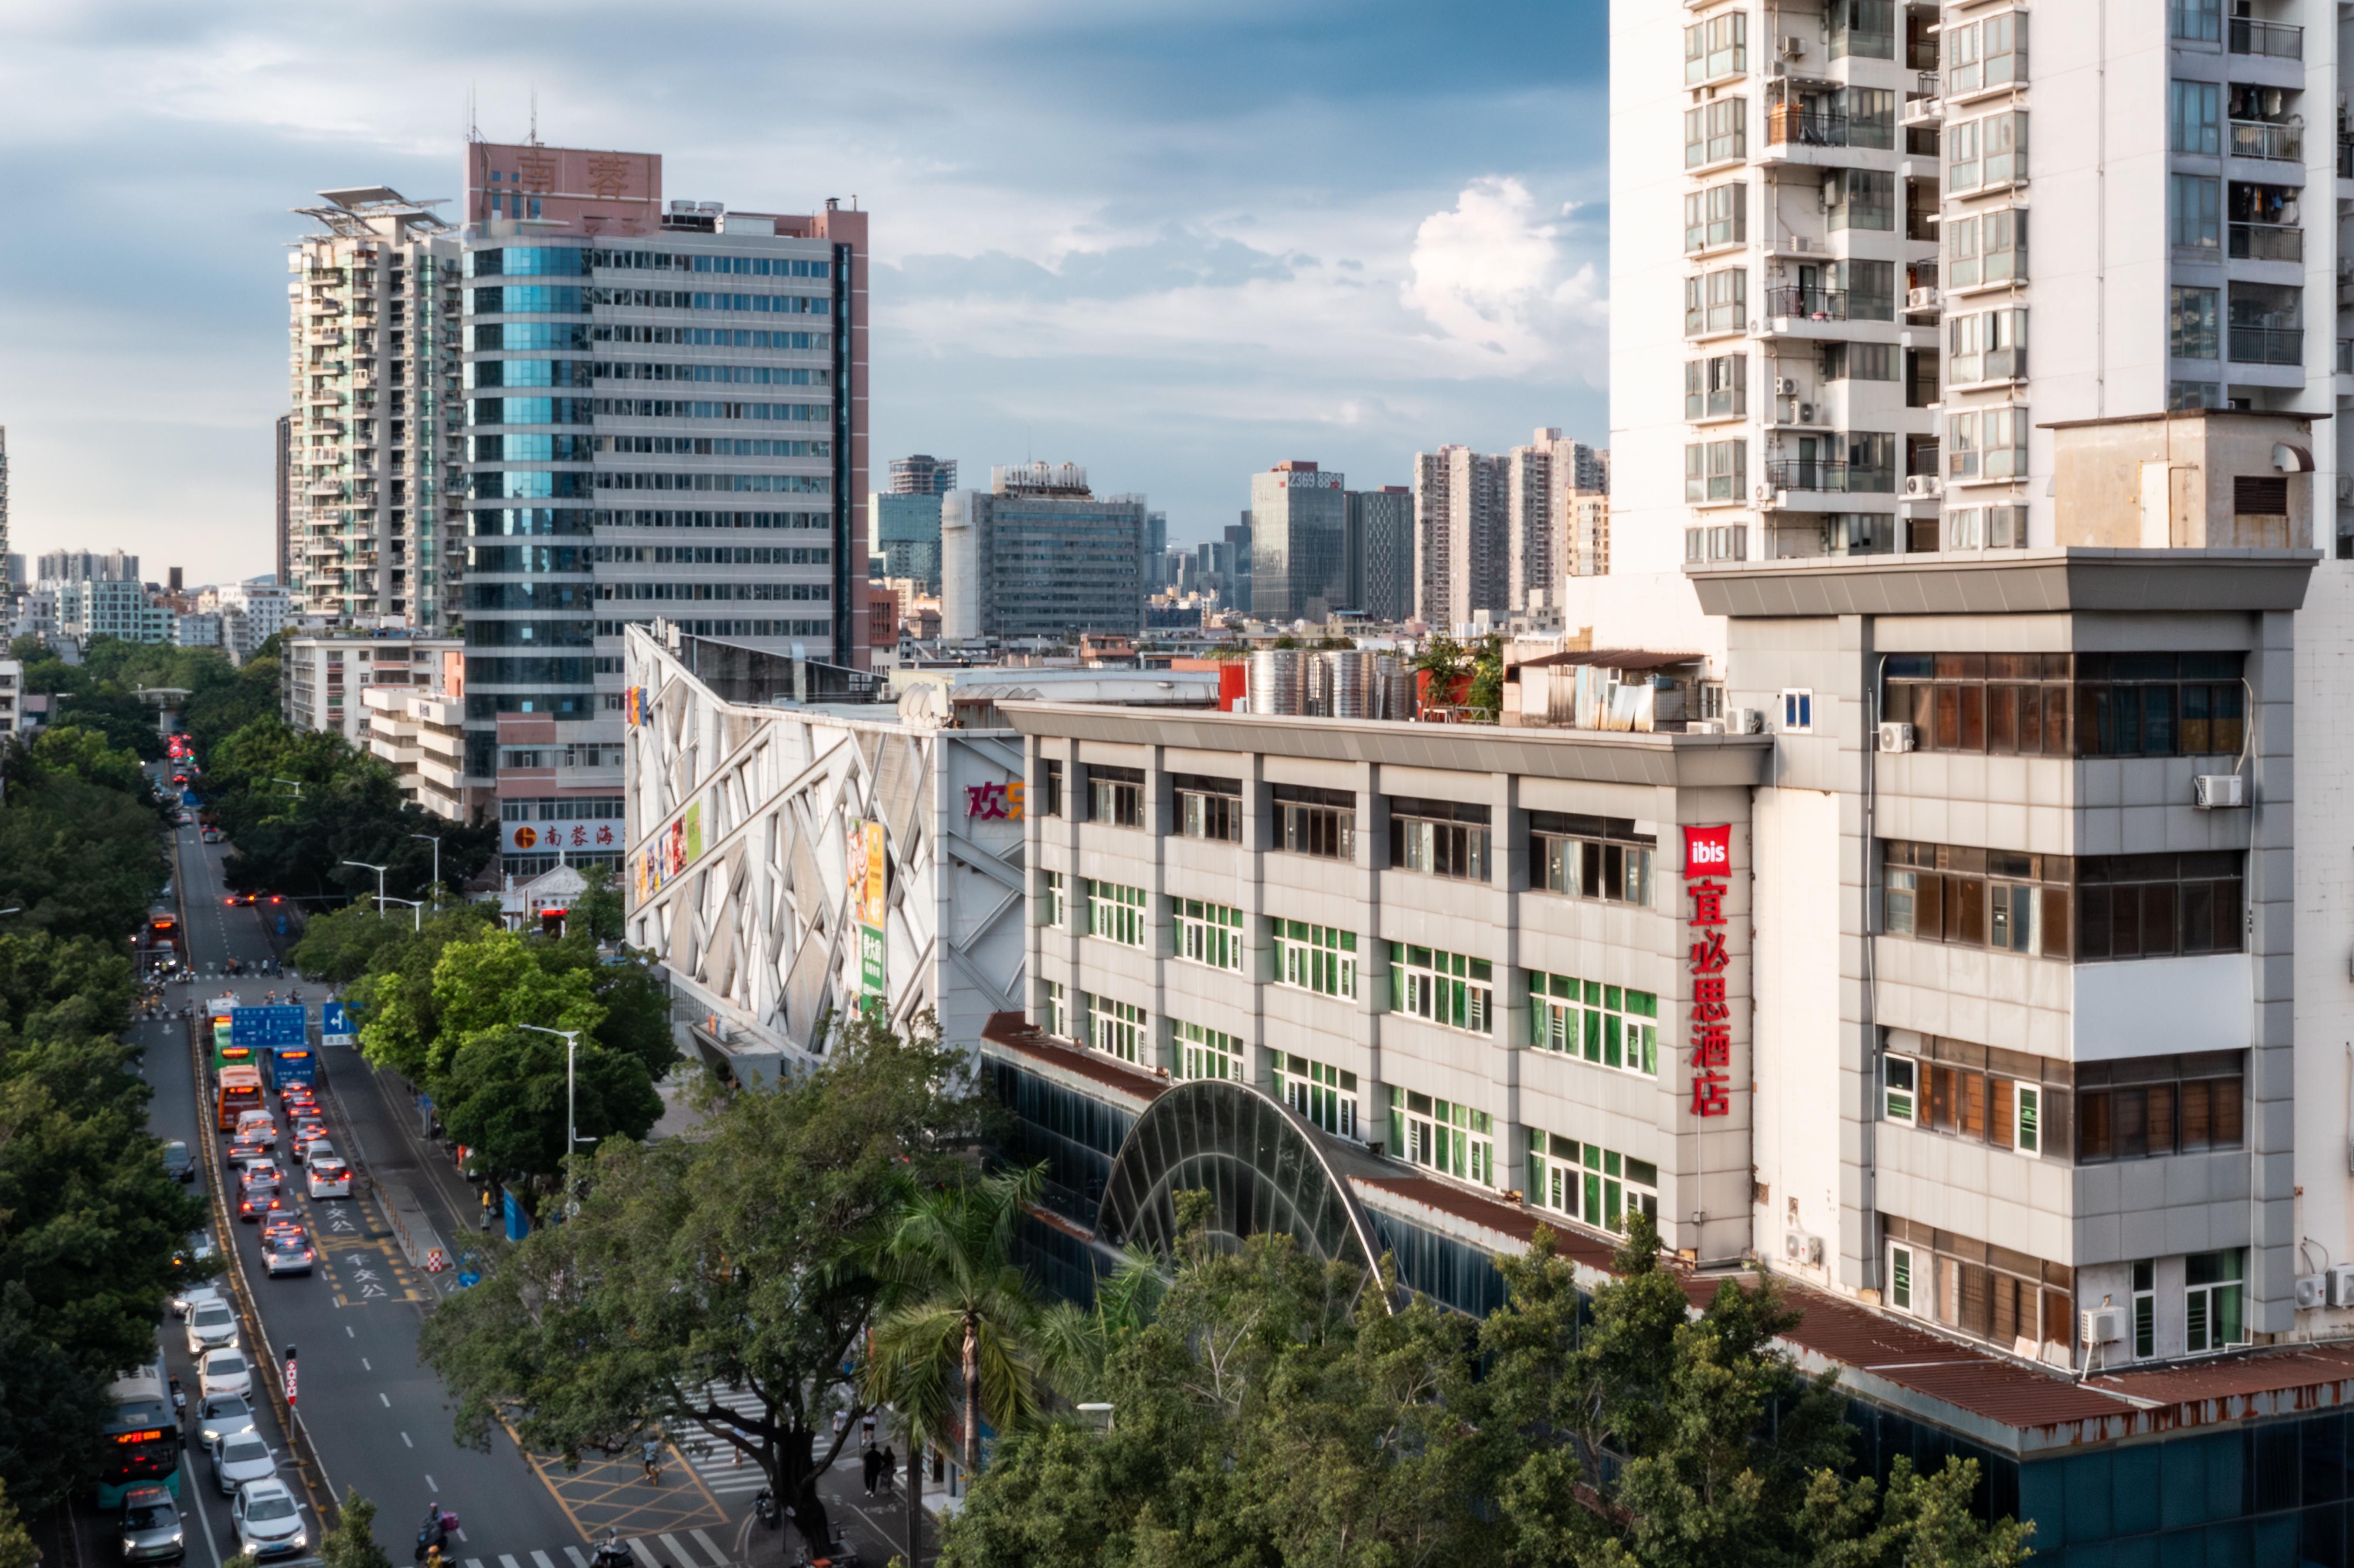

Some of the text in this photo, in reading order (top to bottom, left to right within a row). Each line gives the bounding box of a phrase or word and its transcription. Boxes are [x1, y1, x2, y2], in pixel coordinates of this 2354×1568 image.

[516, 148, 630, 199] 南蓉
[1289, 472, 1315, 487] 2369
[545, 825, 625, 847] 南蓉海
[1692, 840, 1725, 863] ibis
[1688, 880, 1731, 1117] 宜必思酒店
